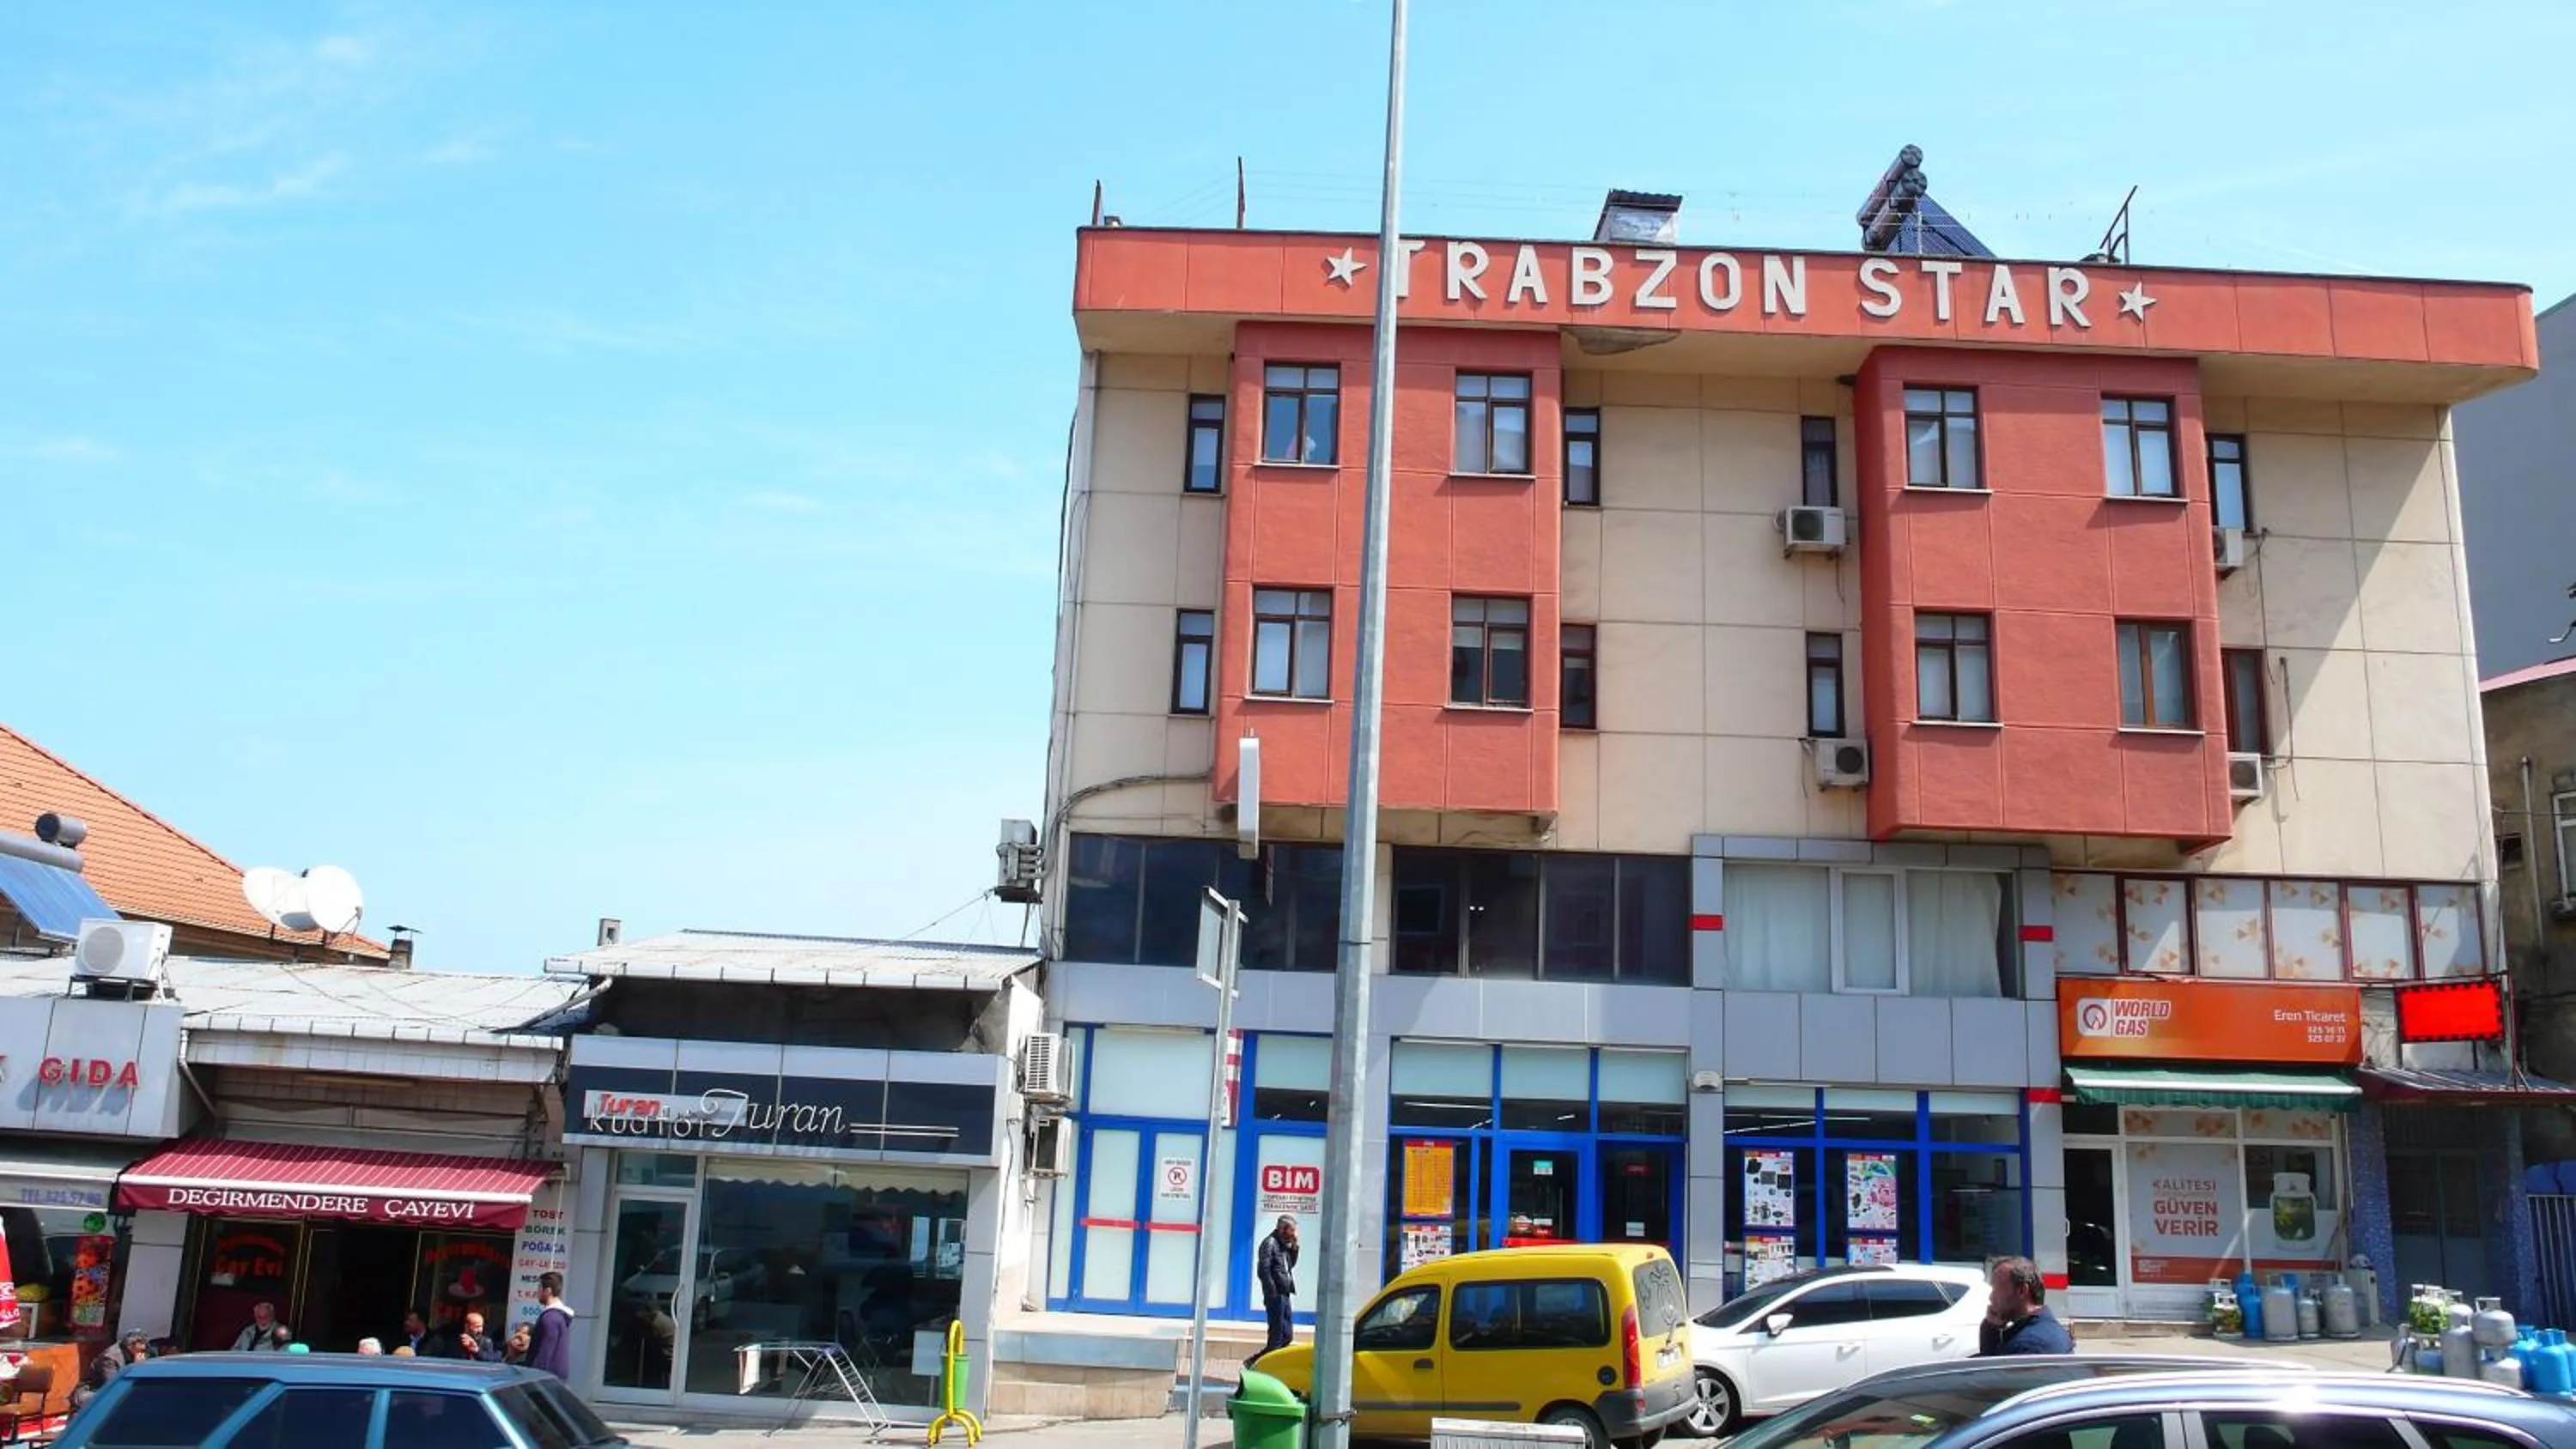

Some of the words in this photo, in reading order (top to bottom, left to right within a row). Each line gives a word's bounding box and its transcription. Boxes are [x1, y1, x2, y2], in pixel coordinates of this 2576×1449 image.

[1396, 240, 1806, 315] TRABZON
[1859, 258, 2092, 328] STAR
[2114, 1000, 2170, 1017] WORLD
[2274, 1009, 2302, 1022] Eren
[2304, 1010, 2347, 1023] Ticaret
[2115, 1019, 2148, 1036] GAS
[39, 1057, 139, 1088] GIDA
[600, 1093, 661, 1115] Turan
[700, 1088, 847, 1138] Turan
[384, 1199, 475, 1219] ÇAYEVİ
[2154, 1216, 2219, 1236] VERİR
